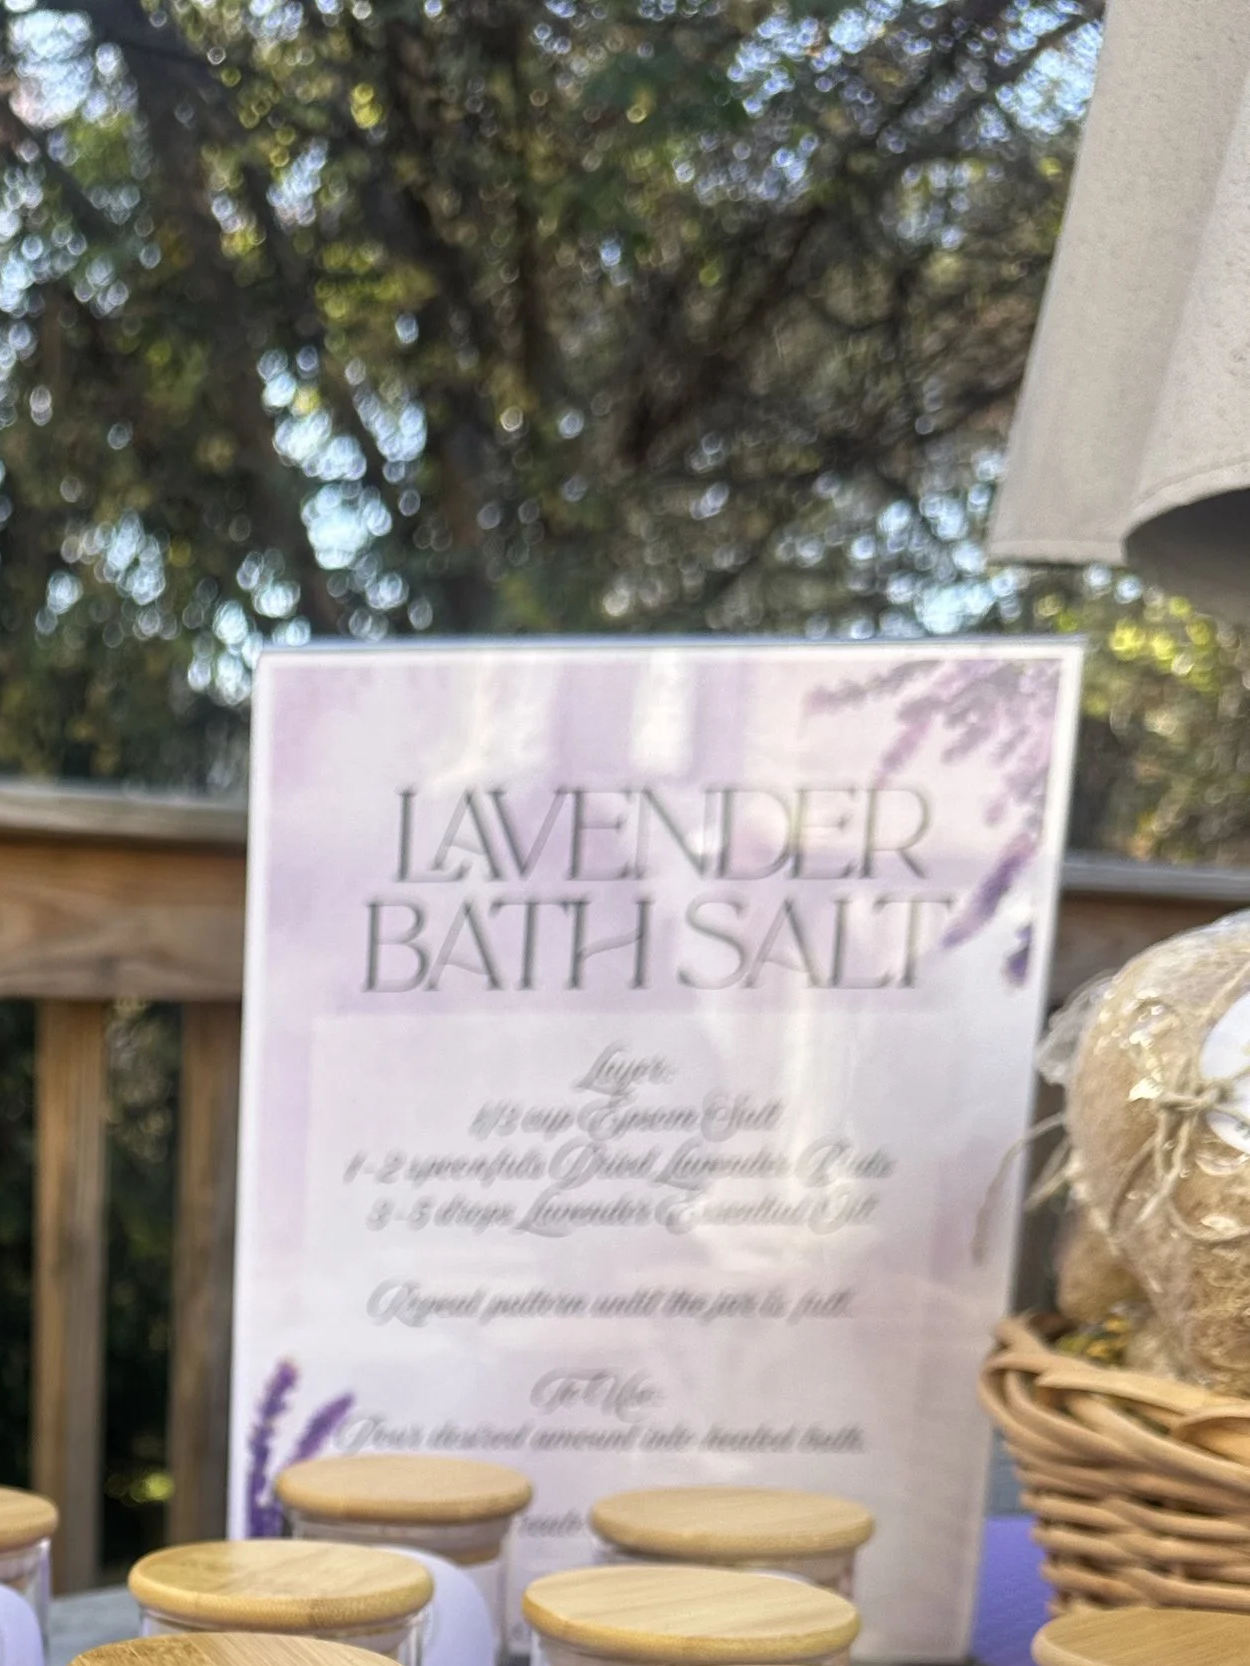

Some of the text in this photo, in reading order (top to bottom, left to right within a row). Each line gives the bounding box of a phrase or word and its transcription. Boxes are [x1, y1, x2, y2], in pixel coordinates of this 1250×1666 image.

[393, 783, 933, 884] LAVENDER
[361, 891, 954, 993] BATH SALT
[508, 1187, 652, 1237] Lavender
[366, 1274, 489, 1328] Repeat
